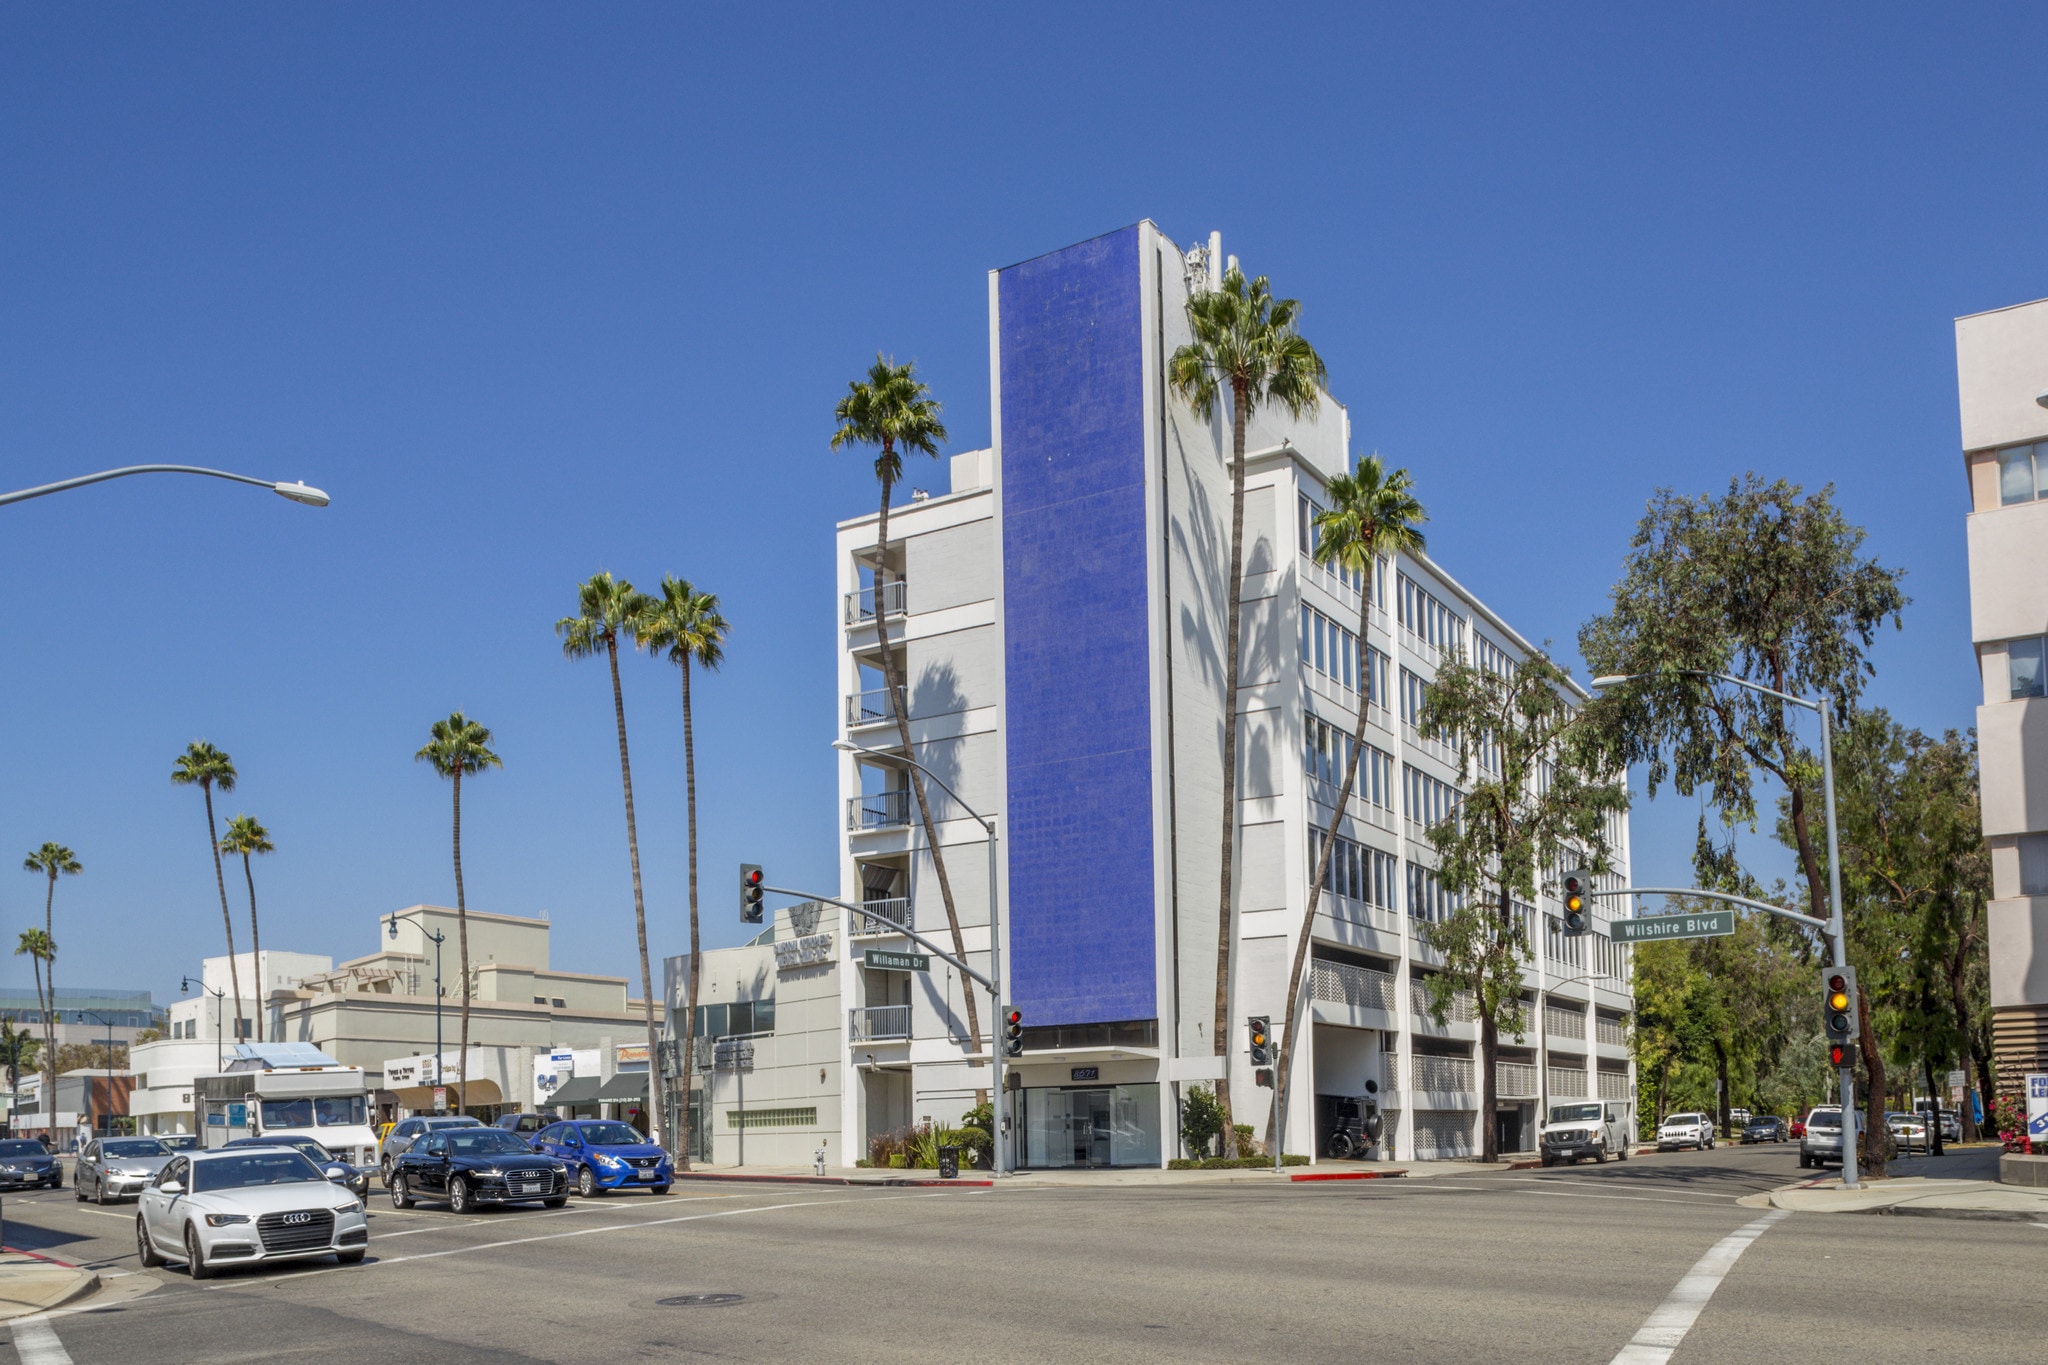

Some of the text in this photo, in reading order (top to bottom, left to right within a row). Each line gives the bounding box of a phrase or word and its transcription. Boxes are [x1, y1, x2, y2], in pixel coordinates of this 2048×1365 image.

[1625, 918, 1718, 937] Wilshire Blvd
[872, 953, 924, 968] Willaman Dr
[2031, 1077, 2048, 1087] FO
